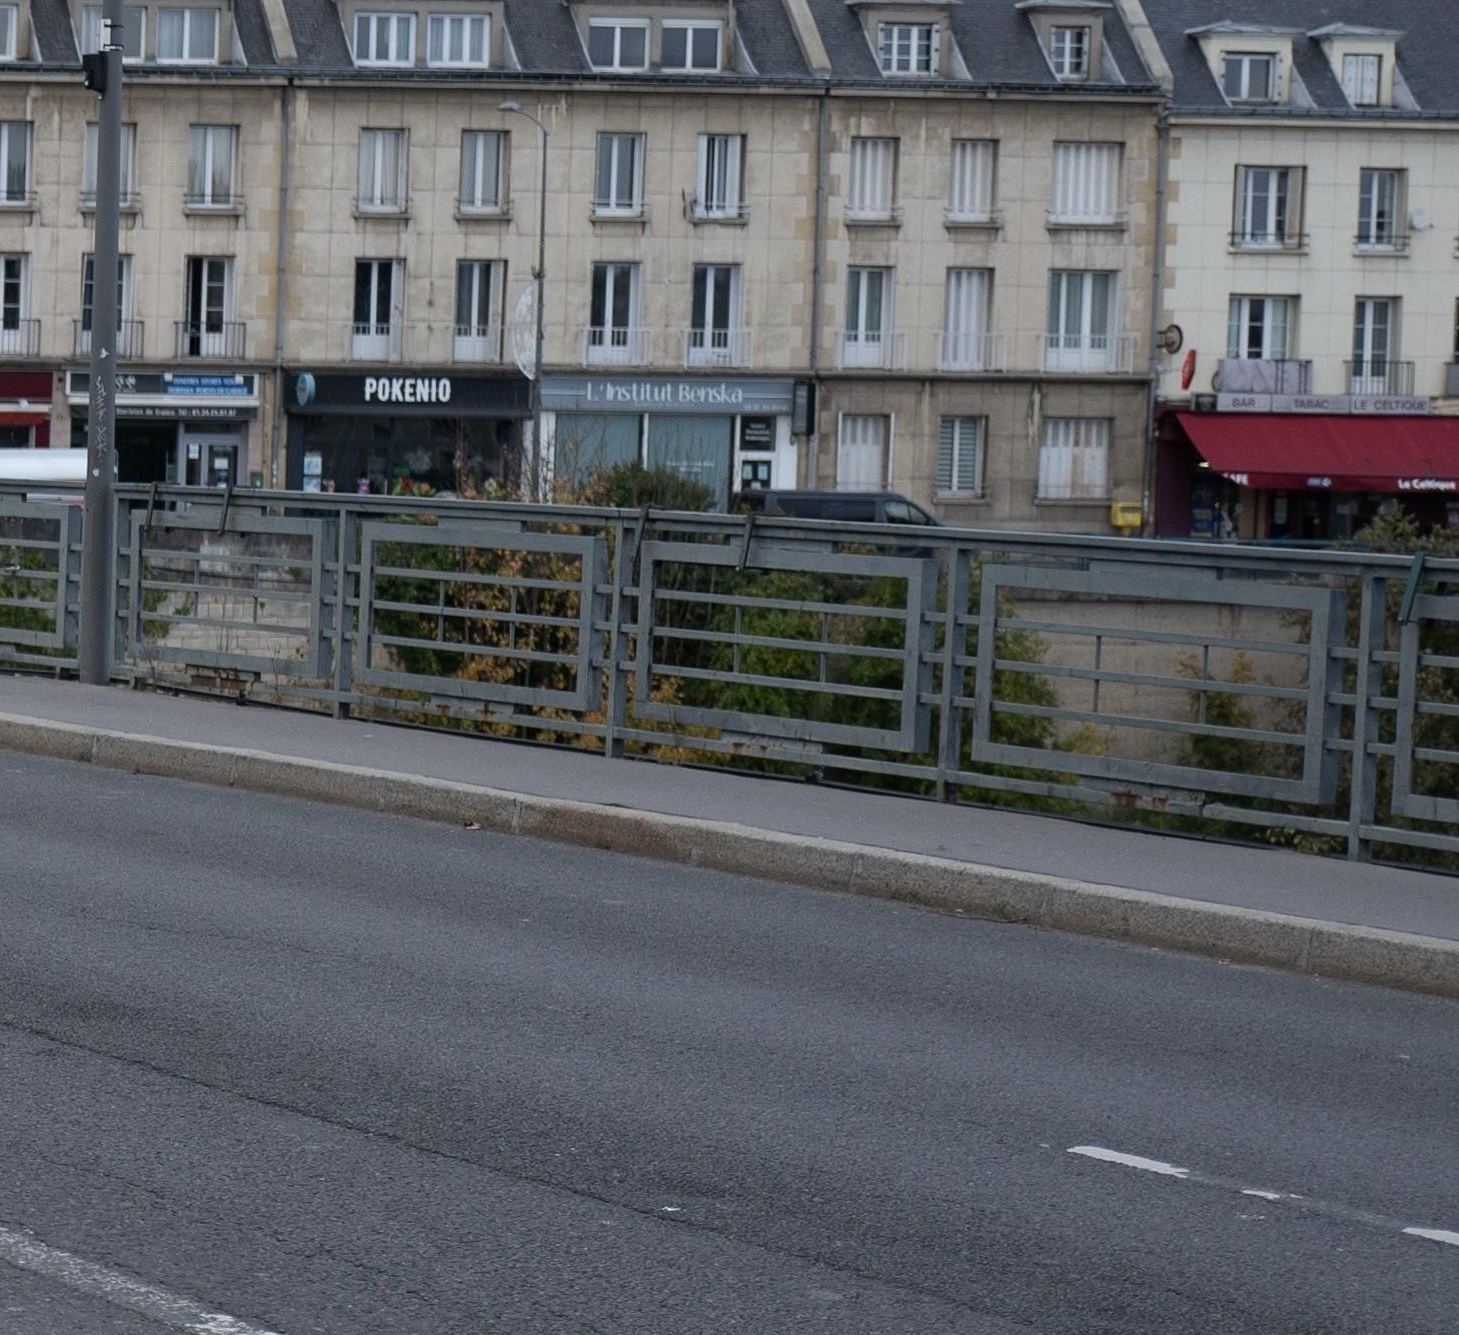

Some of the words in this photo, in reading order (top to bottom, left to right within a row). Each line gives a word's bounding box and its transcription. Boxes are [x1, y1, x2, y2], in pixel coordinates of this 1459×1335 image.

[364, 376, 452, 403] POKENIO
[678, 381, 744, 404] Benska
[1232, 398, 1256, 408] BAR
[1294, 399, 1331, 409] TABAC
[1354, 400, 1367, 410] LE
[1374, 400, 1428, 411] CELTIQUE
